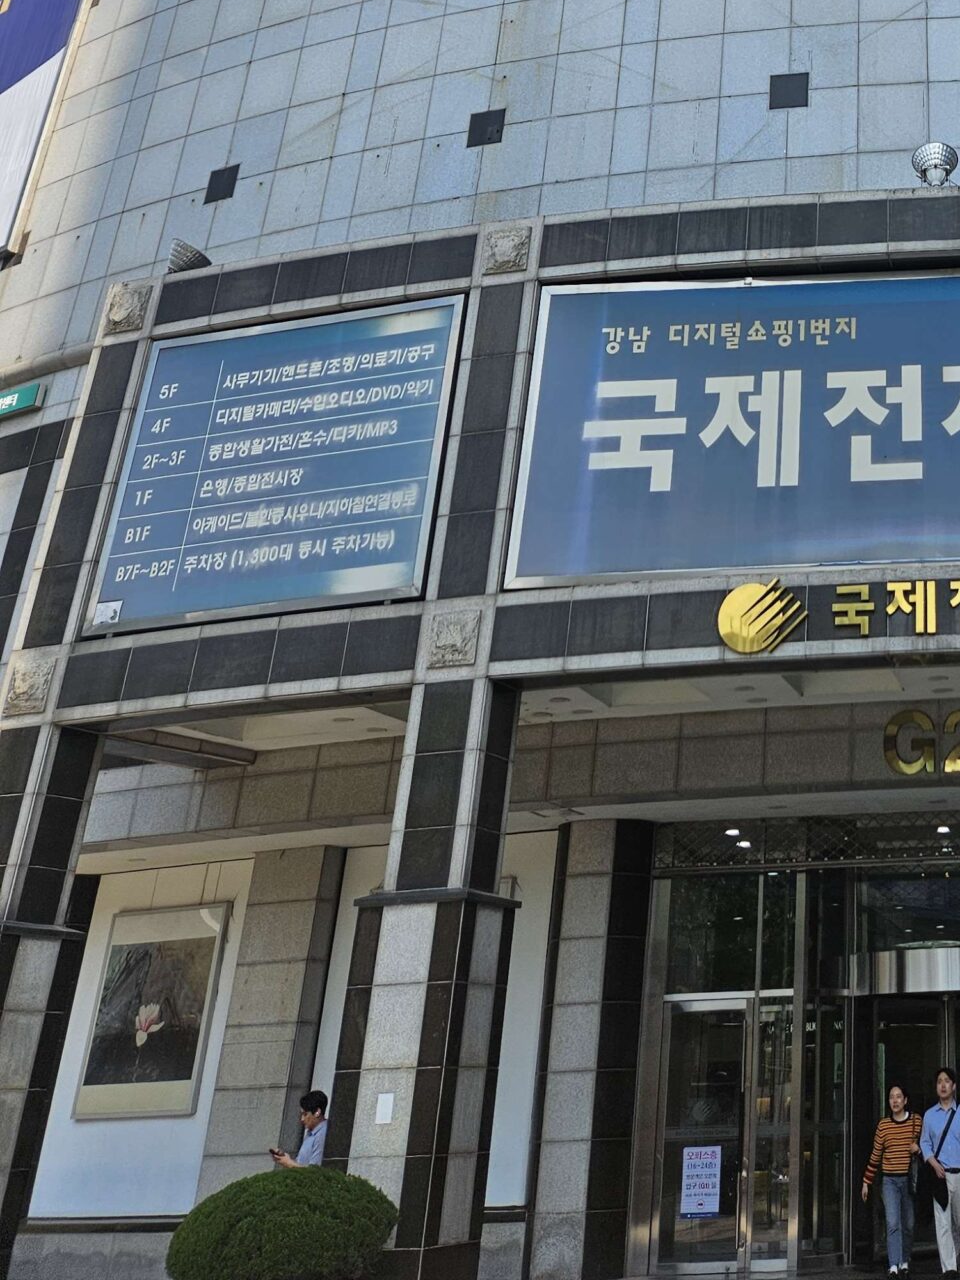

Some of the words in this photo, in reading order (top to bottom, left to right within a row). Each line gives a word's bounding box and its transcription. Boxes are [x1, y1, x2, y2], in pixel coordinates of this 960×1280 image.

[602, 326, 651, 355] 강남
[668, 317, 858, 350] 디지털쇼핑1번지
[159, 383, 179, 400] 5F
[151, 418, 171, 434] 4F
[142, 450, 187, 470] 2F~3F
[135, 490, 154, 506] 1F
[200, 468, 304, 498] 은행/종합전시장
[124, 526, 151, 544] B1F
[115, 559, 176, 582] B7F~B2F
[184, 553, 228, 574] 주차장
[230, 544, 293, 569] (1,300대
[298, 538, 327, 560] 동시
[331, 528, 396, 555] 주차가능)
